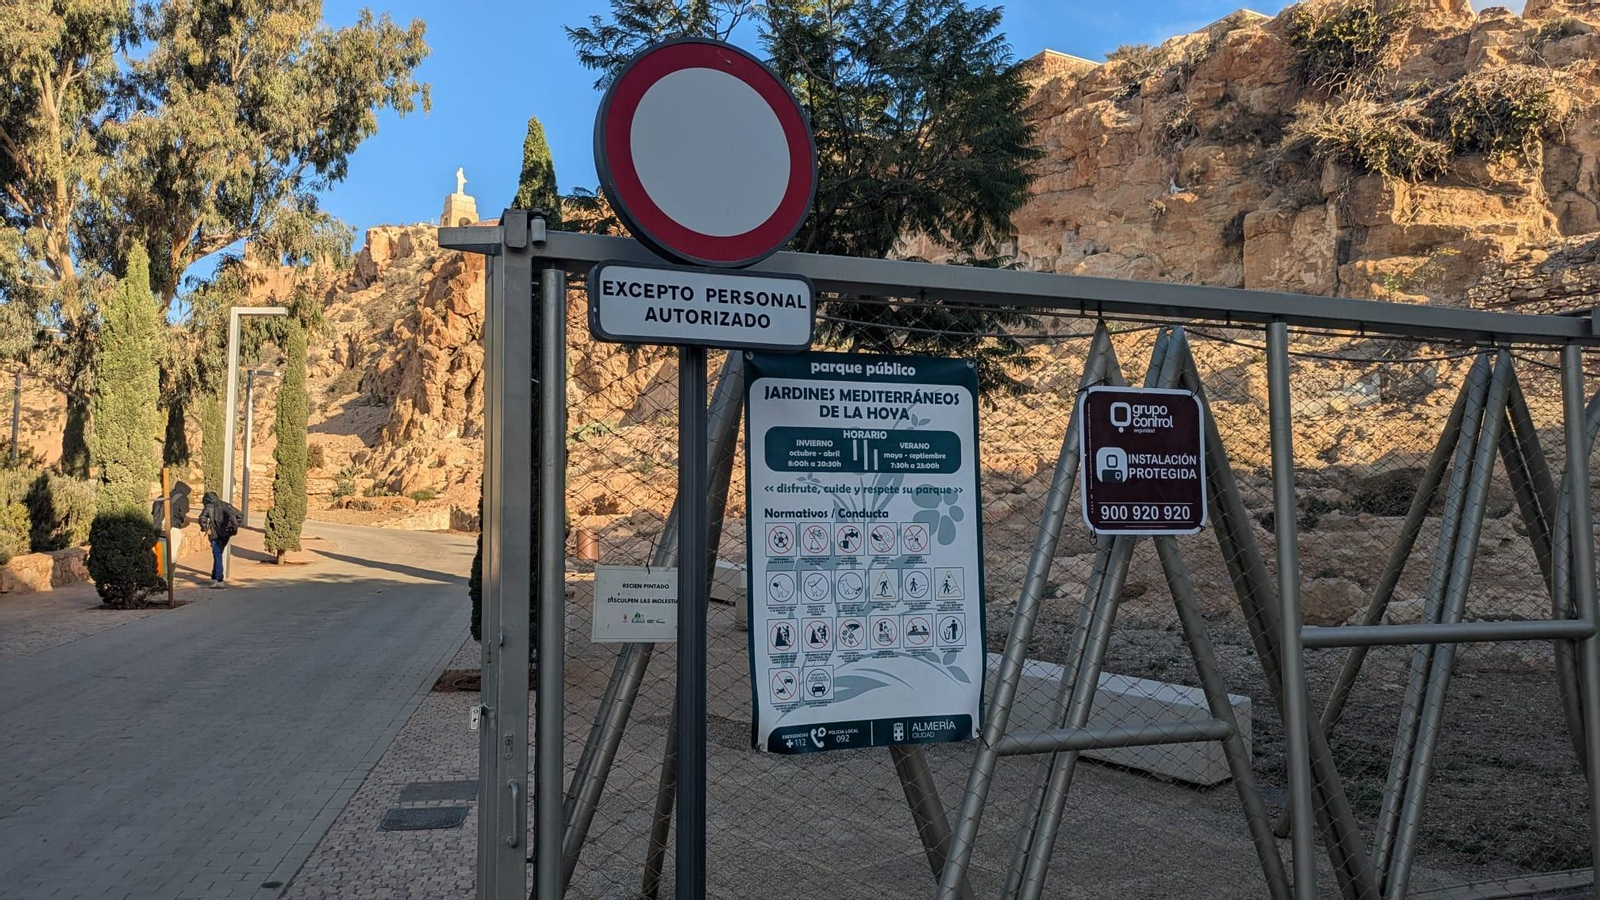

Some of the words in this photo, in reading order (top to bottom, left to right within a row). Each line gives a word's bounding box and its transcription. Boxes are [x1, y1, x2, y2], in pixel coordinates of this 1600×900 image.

[603, 281, 694, 301] EXCEPTO
[706, 288, 807, 309] PERSONAL
[645, 307, 770, 328] AUTORIZADO
[811, 362, 862, 376] parque
[867, 361, 916, 376] público
[764, 386, 835, 400] JARDINES
[840, 389, 959, 405] MEDITERRÁNEOS
[820, 405, 839, 418] DE
[844, 407, 863, 419] LA
[867, 407, 910, 420] HOYA
[1133, 404, 1167, 416] grupo
[1133, 416, 1173, 428] control
[843, 430, 887, 439] HORARIO
[910, 452, 946, 460] septiembre
[1129, 453, 1196, 465] INSTALACIÓN
[1129, 468, 1196, 479] PROTEGIDA
[777, 484, 821, 494] disfrute,
[824, 484, 852, 494] cuide
[854, 487, 860, 495] y
[863, 486, 899, 496] respete
[916, 487, 952, 496] parque
[838, 508, 889, 519] Conducta
[1101, 506, 1128, 520] 900
[1133, 506, 1159, 520] 920
[1164, 506, 1190, 520] 920
[912, 720, 956, 731] ALMERÍA
[795, 739, 806, 747] 112
